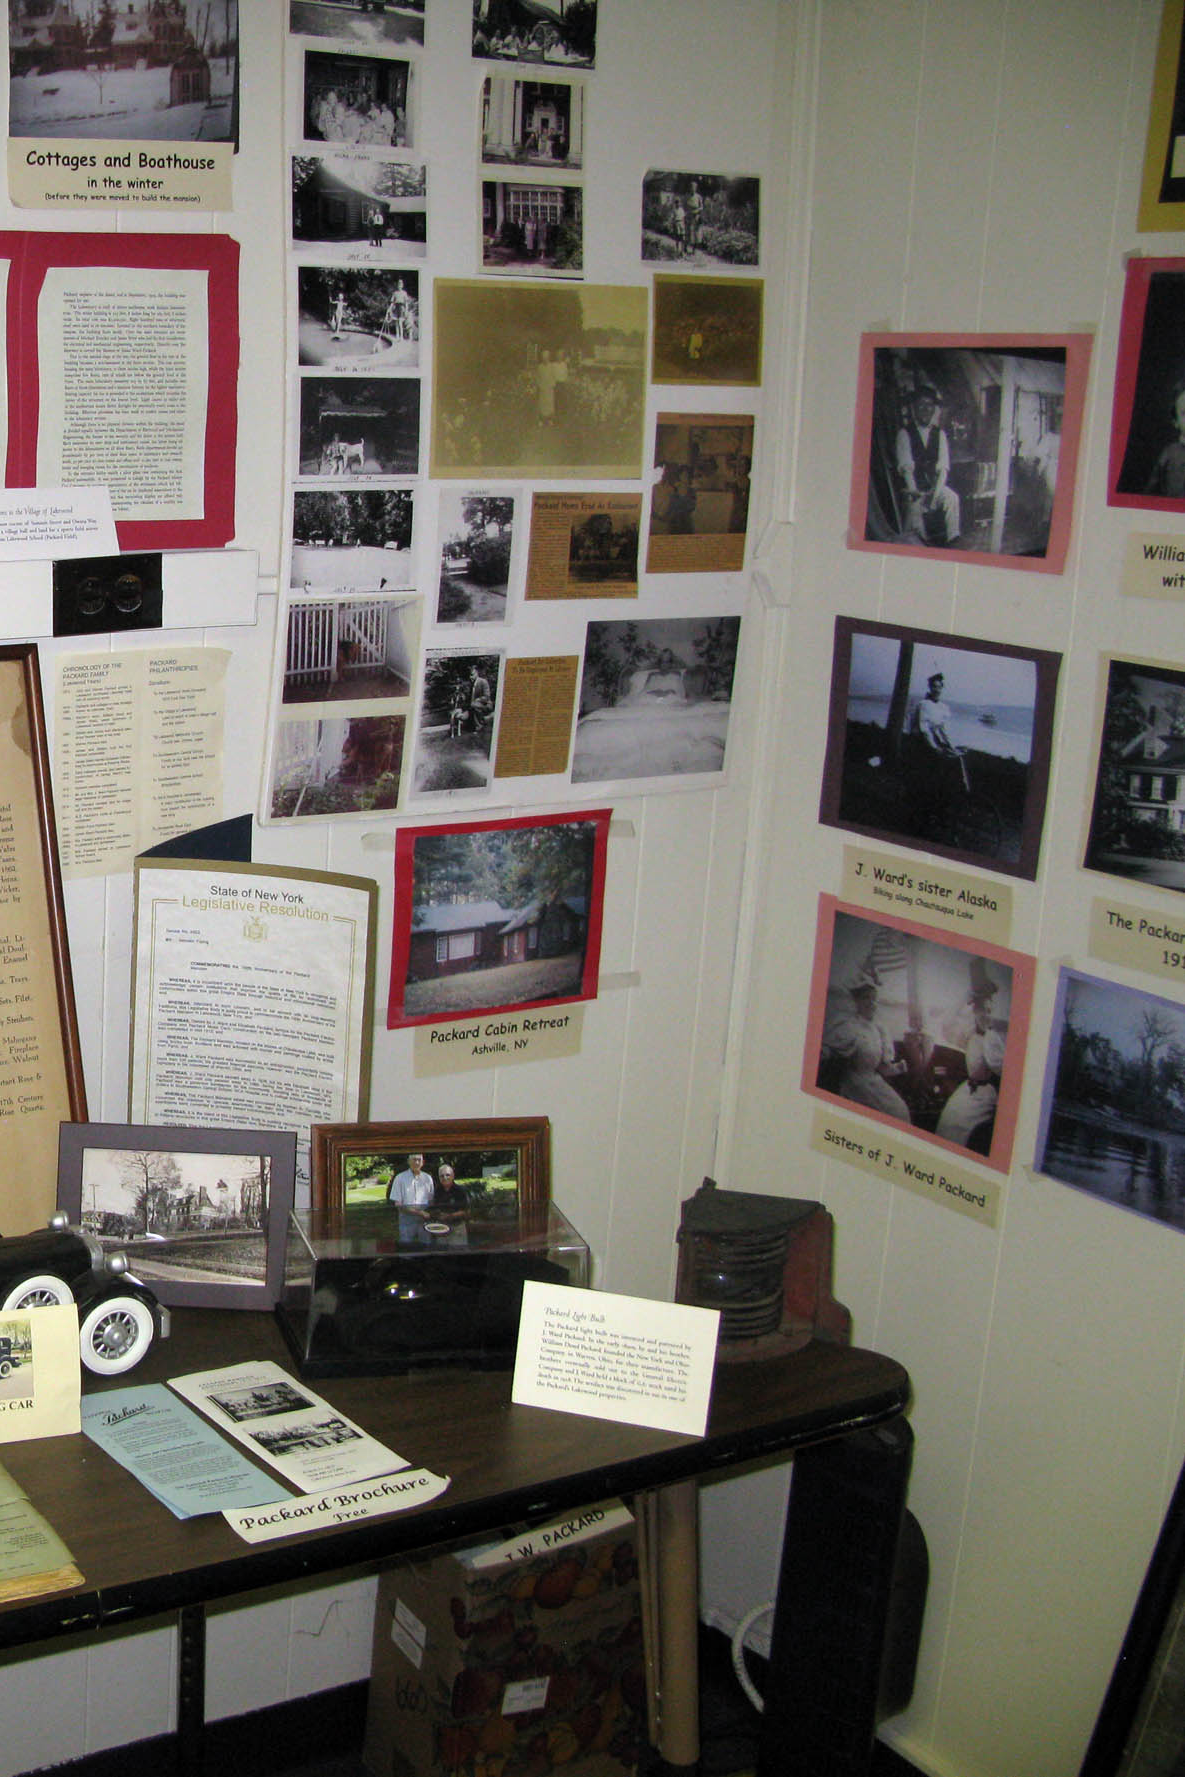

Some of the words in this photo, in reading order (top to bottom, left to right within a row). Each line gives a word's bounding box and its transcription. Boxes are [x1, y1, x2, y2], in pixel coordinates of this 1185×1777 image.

[26, 151, 96, 170] Cottages
[104, 153, 131, 167] and
[139, 153, 215, 170] Boathouse
[87, 178, 97, 188] in
[103, 177, 122, 189] the
[127, 179, 164, 189] winter
[73, 194, 87, 202] they
[211, 886, 238, 897] State
[242, 888, 251, 898] of
[255, 890, 277, 900] New
[282, 892, 304, 904] York
[855, 863, 867, 877] J.
[874, 867, 913, 888] Ward's
[918, 880, 952, 898] sister
[958, 889, 997, 911] Alaska
[182, 896, 254, 913] Legislative
[260, 903, 329, 921] Resolution
[1107, 910, 1132, 930] The
[430, 1026, 479, 1043] Packard
[485, 1022, 517, 1037] Cabin
[523, 1016, 569, 1031] Retreat
[472, 1042, 509, 1055] Ashville,
[514, 1039, 528, 1050] NY
[824, 1129, 863, 1154] Sisters
[868, 1149, 881, 1161] of
[885, 1154, 897, 1169] J.
[904, 1160, 935, 1185] Ward
[939, 1176, 986, 1207] Packard
[10, 1400, 34, 1411] CAR
[239, 1498, 331, 1530] Packard
[334, 1476, 430, 1508] Brochure
[334, 1507, 369, 1523] Free
[543, 1510, 605, 1547] PACKARD
